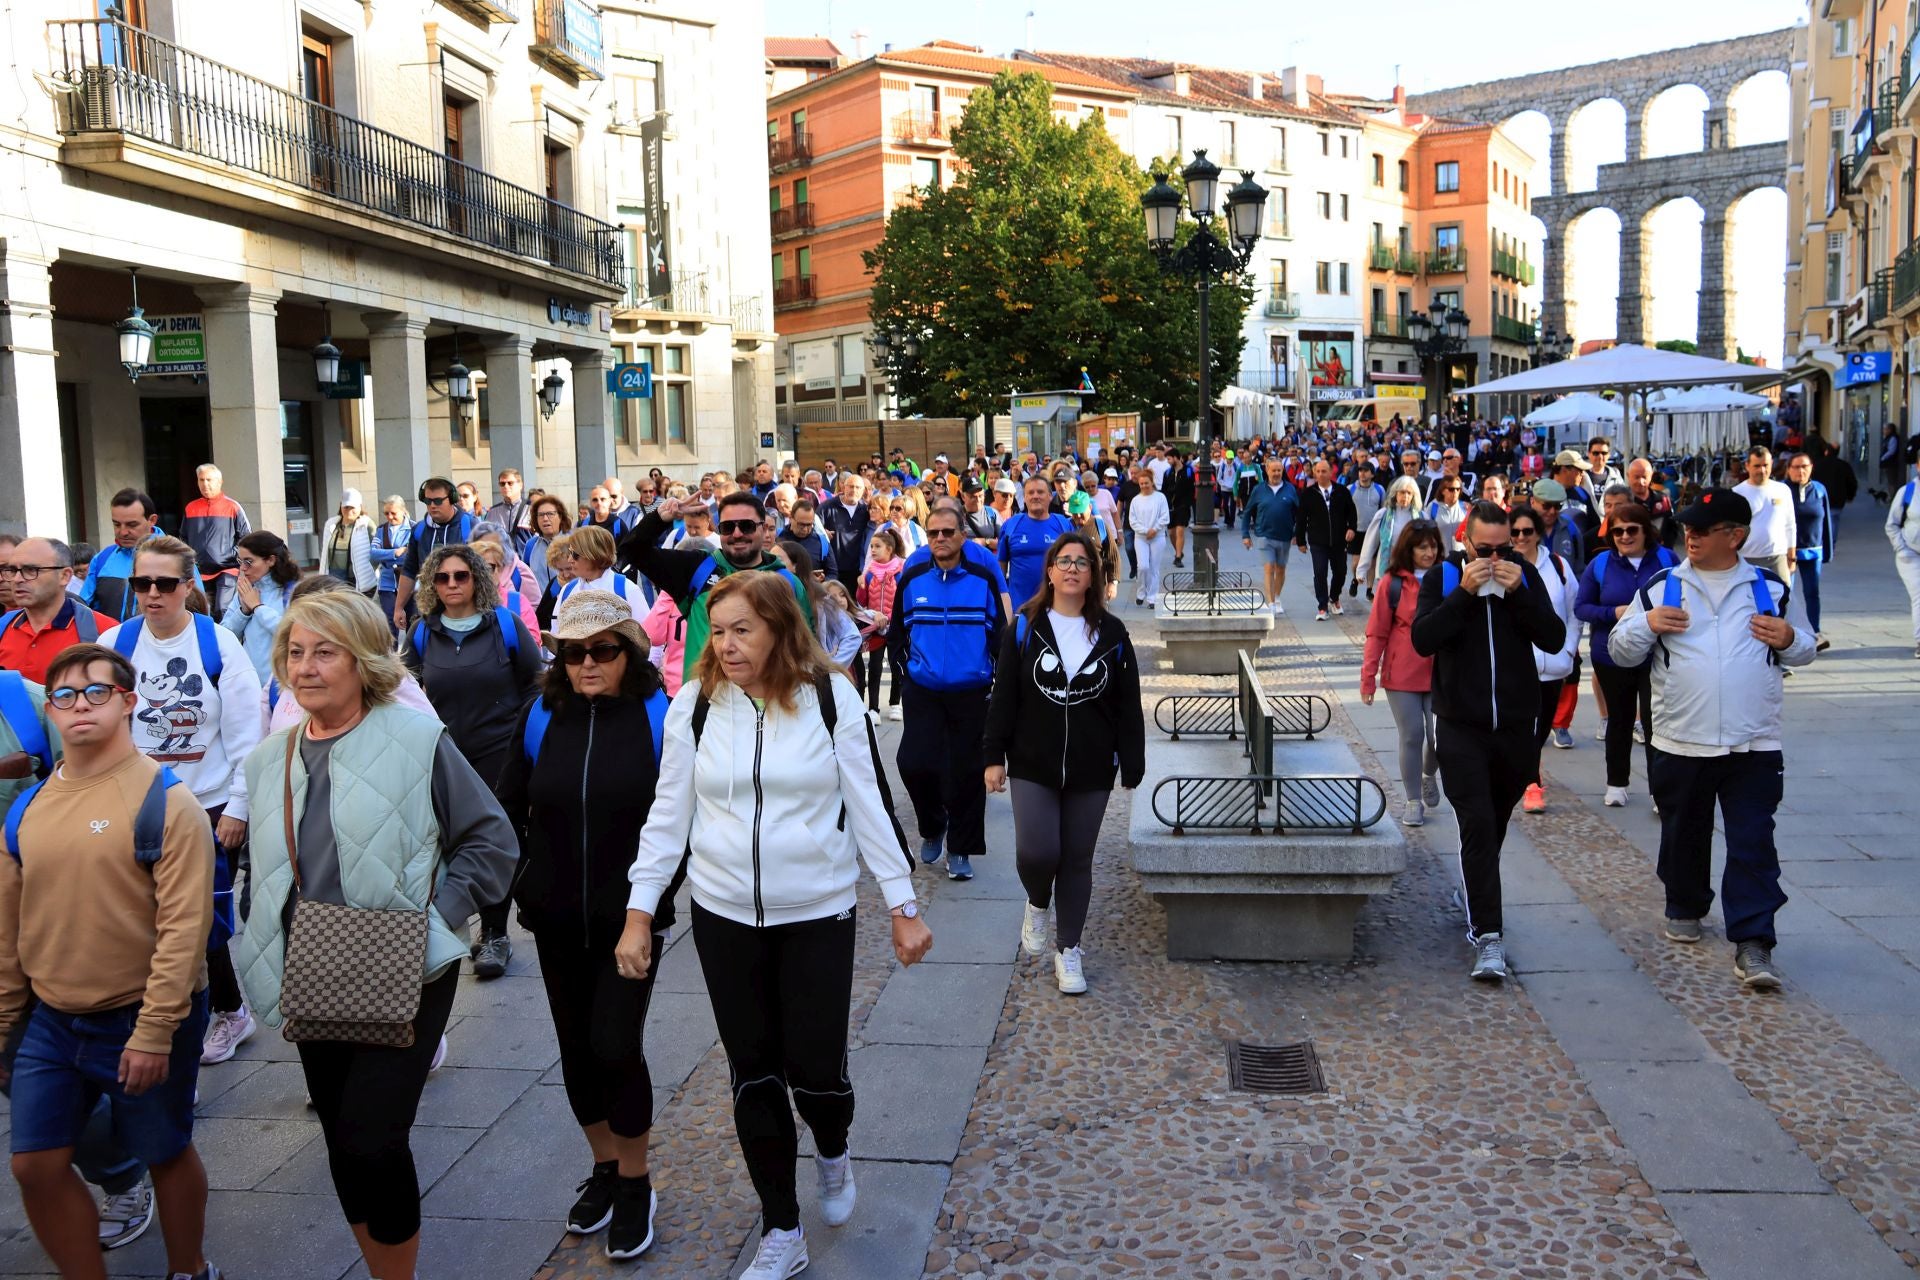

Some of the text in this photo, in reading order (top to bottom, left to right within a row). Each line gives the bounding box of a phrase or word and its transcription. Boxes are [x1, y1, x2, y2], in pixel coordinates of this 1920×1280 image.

[647, 137, 659, 236] CaixaBank
[170, 316, 201, 331] DENTAL
[161, 339, 196, 347] IMPLANTES
[159, 348, 200, 356] ORTODONCIA
[173, 364, 195, 372] PLANTA
[1852, 372, 1876, 381] ATM
